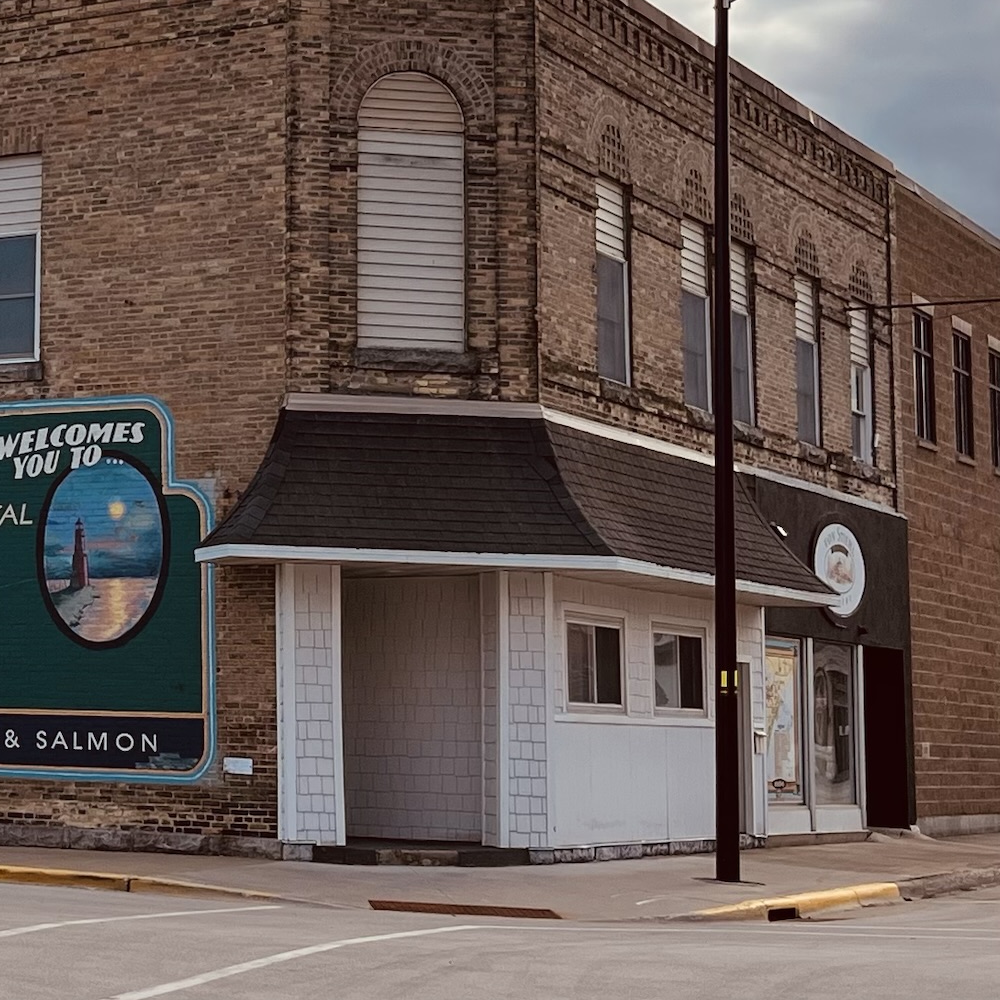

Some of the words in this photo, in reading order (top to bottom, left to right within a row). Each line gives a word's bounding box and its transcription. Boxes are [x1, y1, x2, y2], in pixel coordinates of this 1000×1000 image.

[13, 450, 61, 480] YOU
[4, 729, 21, 749] &
[35, 730, 158, 753] SALMON
